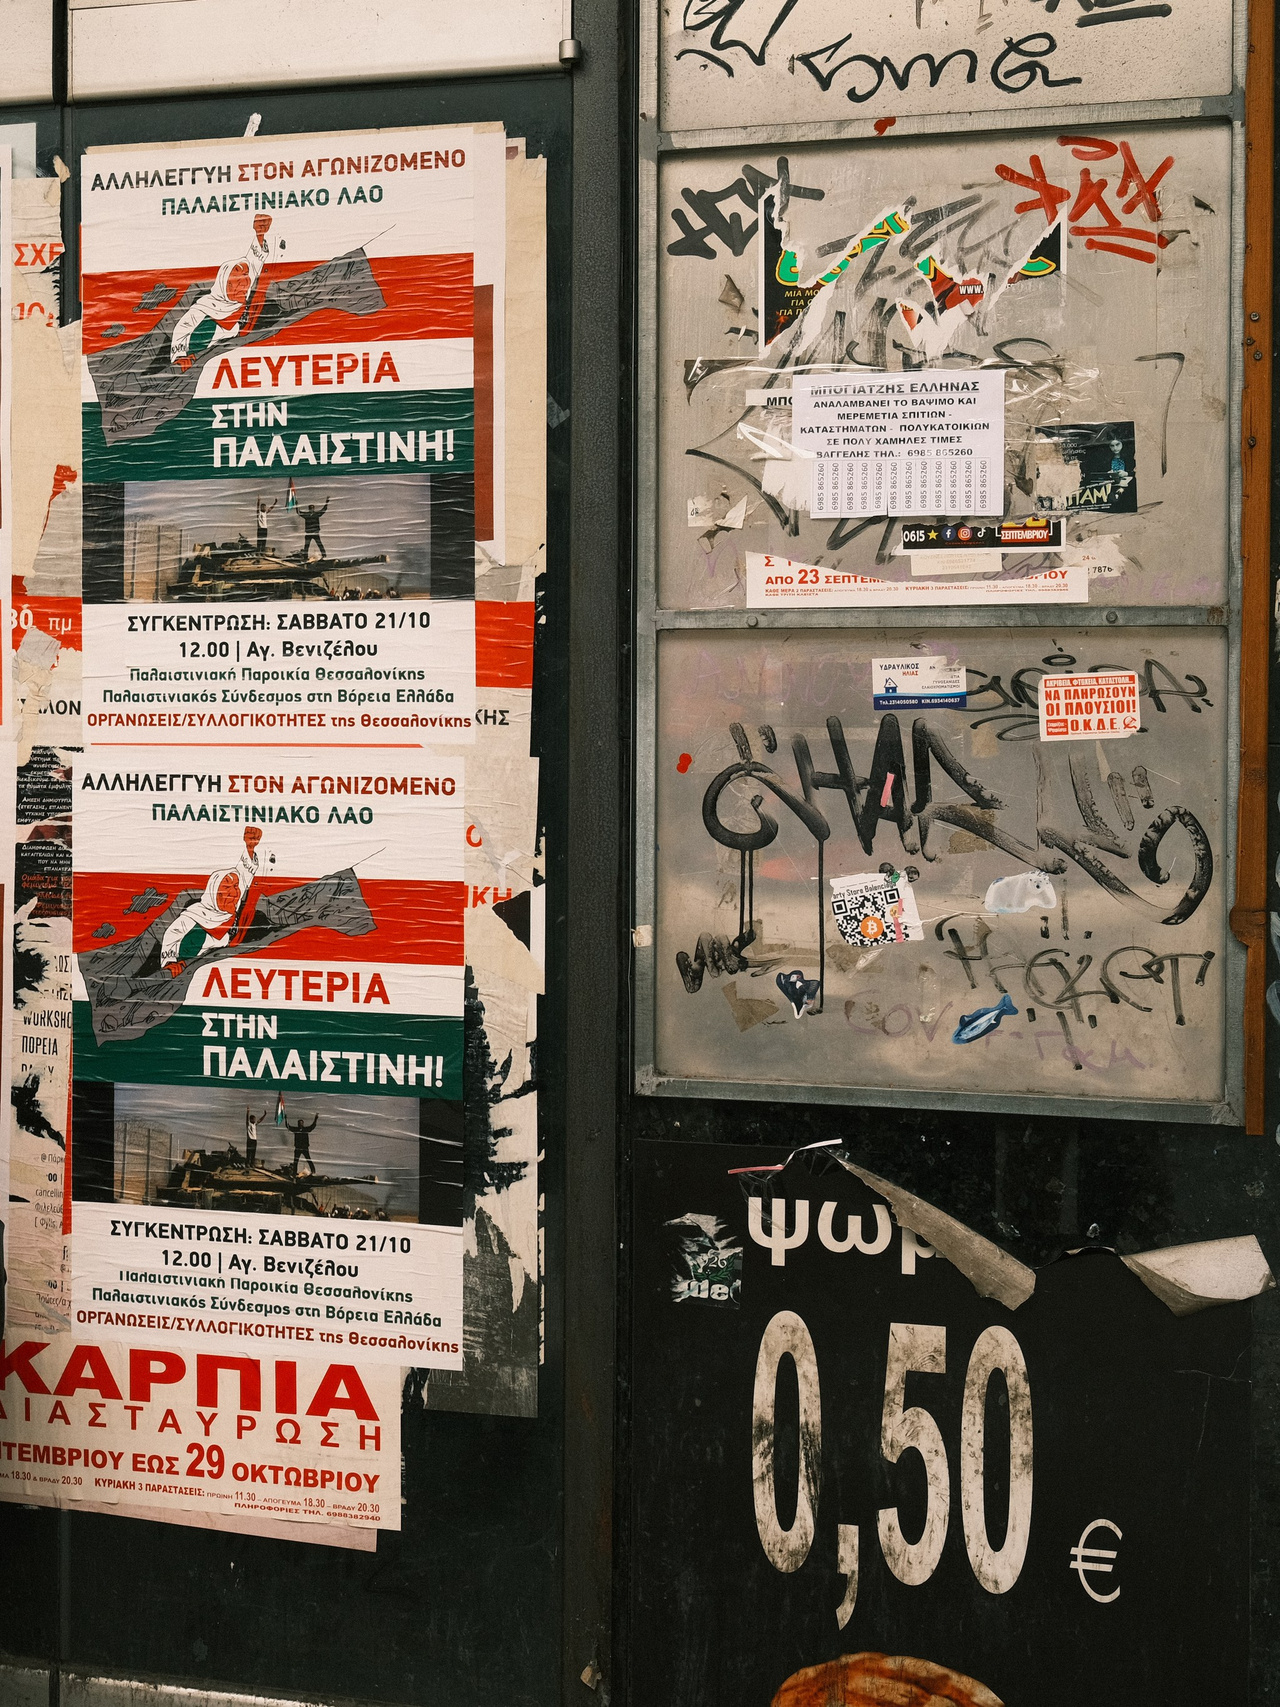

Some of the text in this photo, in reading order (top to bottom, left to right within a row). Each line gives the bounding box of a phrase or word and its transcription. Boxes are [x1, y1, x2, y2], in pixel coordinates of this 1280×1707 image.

[90, 148, 466, 192] ΑΛΛΗΛΕΓΓΥΗ ΣΤΟΝ ΑΓΩΝΙΖΟΜΕΝΟ
[161, 184, 383, 216] ΠΑΛΑΙΣΤΙΝΙΑΚΟ ΛΑΟ
[212, 351, 401, 390] ΛΕΥΤΕΡΙΑ
[910, 381, 980, 393] ΕΛΛΗΝΑΣ
[813, 397, 976, 409] ΑΝΑΛΑΜΒΑΝΕΙ ΤΟ ΒΑΨΙΜΟ ΚΑΙ
[211, 401, 288, 429] ΣΤΗΝ
[837, 411, 946, 420] ΜΕΡΕΜΕΤΙΑ ΣΠΙΤΙΩΝ
[800, 422, 990, 434] ΚΑΤΑΣΤΗΜΑΤΩΝ ΠΟΛΥΚΑΤΟΙΚΙΩΝ
[213, 429, 455, 468] ΠΑΛΑΙΣΤΙΝΗ!
[827, 435, 963, 446] ΣΕ ΠΟΛΥ ΧΑΜΗΛΕΣ ΤΙΜΕΣ
[765, 568, 820, 585] ΑΠΟ 23
[127, 612, 431, 632] ΣΥΓΚΕΝΤΡΩΣΗ: ΣΑΒΒΑΤΟ 21/10
[179, 640, 378, 661] 12.00 Αγ. Βενιζέλου
[130, 667, 425, 684] Παλαιστινιακή Παροικία Θεσσαλονίκης
[879, 663, 920, 671] ΥΔΡΑΥΛΙΚΟΣ
[103, 688, 454, 706] Παλαιστινιακός Σύνδεσμος στη Βόρεια Ελλάδα
[1045, 686, 1136, 701] ΝΑ ΠΛΗΡΩΣΟΥΝ
[1046, 700, 1136, 716] ΟΙ ΠΛΟΥΣΙΟΙ!
[87, 712, 472, 728] ΟΡΓΑΝΩΣΕΙΣ/ΣΥΛΛΟΓΙΚΟΤΗΤΕΣ της Θεσσαλονίκης
[1070, 718, 1121, 731] Ο.Κ.Δ.Ε.
[81, 772, 456, 796] ΑΛΛΗΛΕΓΓΥΗ ΣΤΟΝ ΑΓΩΝΙΖΟΜΕΝΟ
[152, 803, 374, 824] ΠΑΛΑΙΣΤΙΝΙΑΚΟ ΛΑΟ
[202, 967, 391, 1005] ΛΕΥΤΕΡΙΑ
[201, 1012, 278, 1040] ΣΤΗΝ
[21, 1036, 58, 1056] ΠΟΡΕΙΑ
[202, 1046, 443, 1088] ΠΑΛΑΙΣΤΙΝΗ!
[110, 1219, 411, 1254] ΣΥΓΚΕΝΤΡΩΣΗ: ΣΑΒΒΑΤΟ 21/10
[162, 1249, 359, 1279] 12.00 Βενιζέλου
[230, 1277, 413, 1303] Παροικία Θεσσαλονίκης
[92, 1287, 206, 1309] Παλαιστινιακός
[210, 1296, 291, 1317] Σύνδεσμος
[348, 1332, 459, 1354] Θεσσαλονίκης
[132, 1453, 180, 1475] ΕΩΣ
[185, 1442, 225, 1480] 29
[232, 1462, 380, 1493] ΟΚΤΩΒΡΙΟΥ
[752, 1309, 1034, 1631] 0,50
[11, 1471, 31, 1481] 18.30
[61, 1476, 83, 1486] 20.30
[95, 1477, 380, 1513] ΚΥΡΙΑΚΗ 11.30 18.30 20.30
